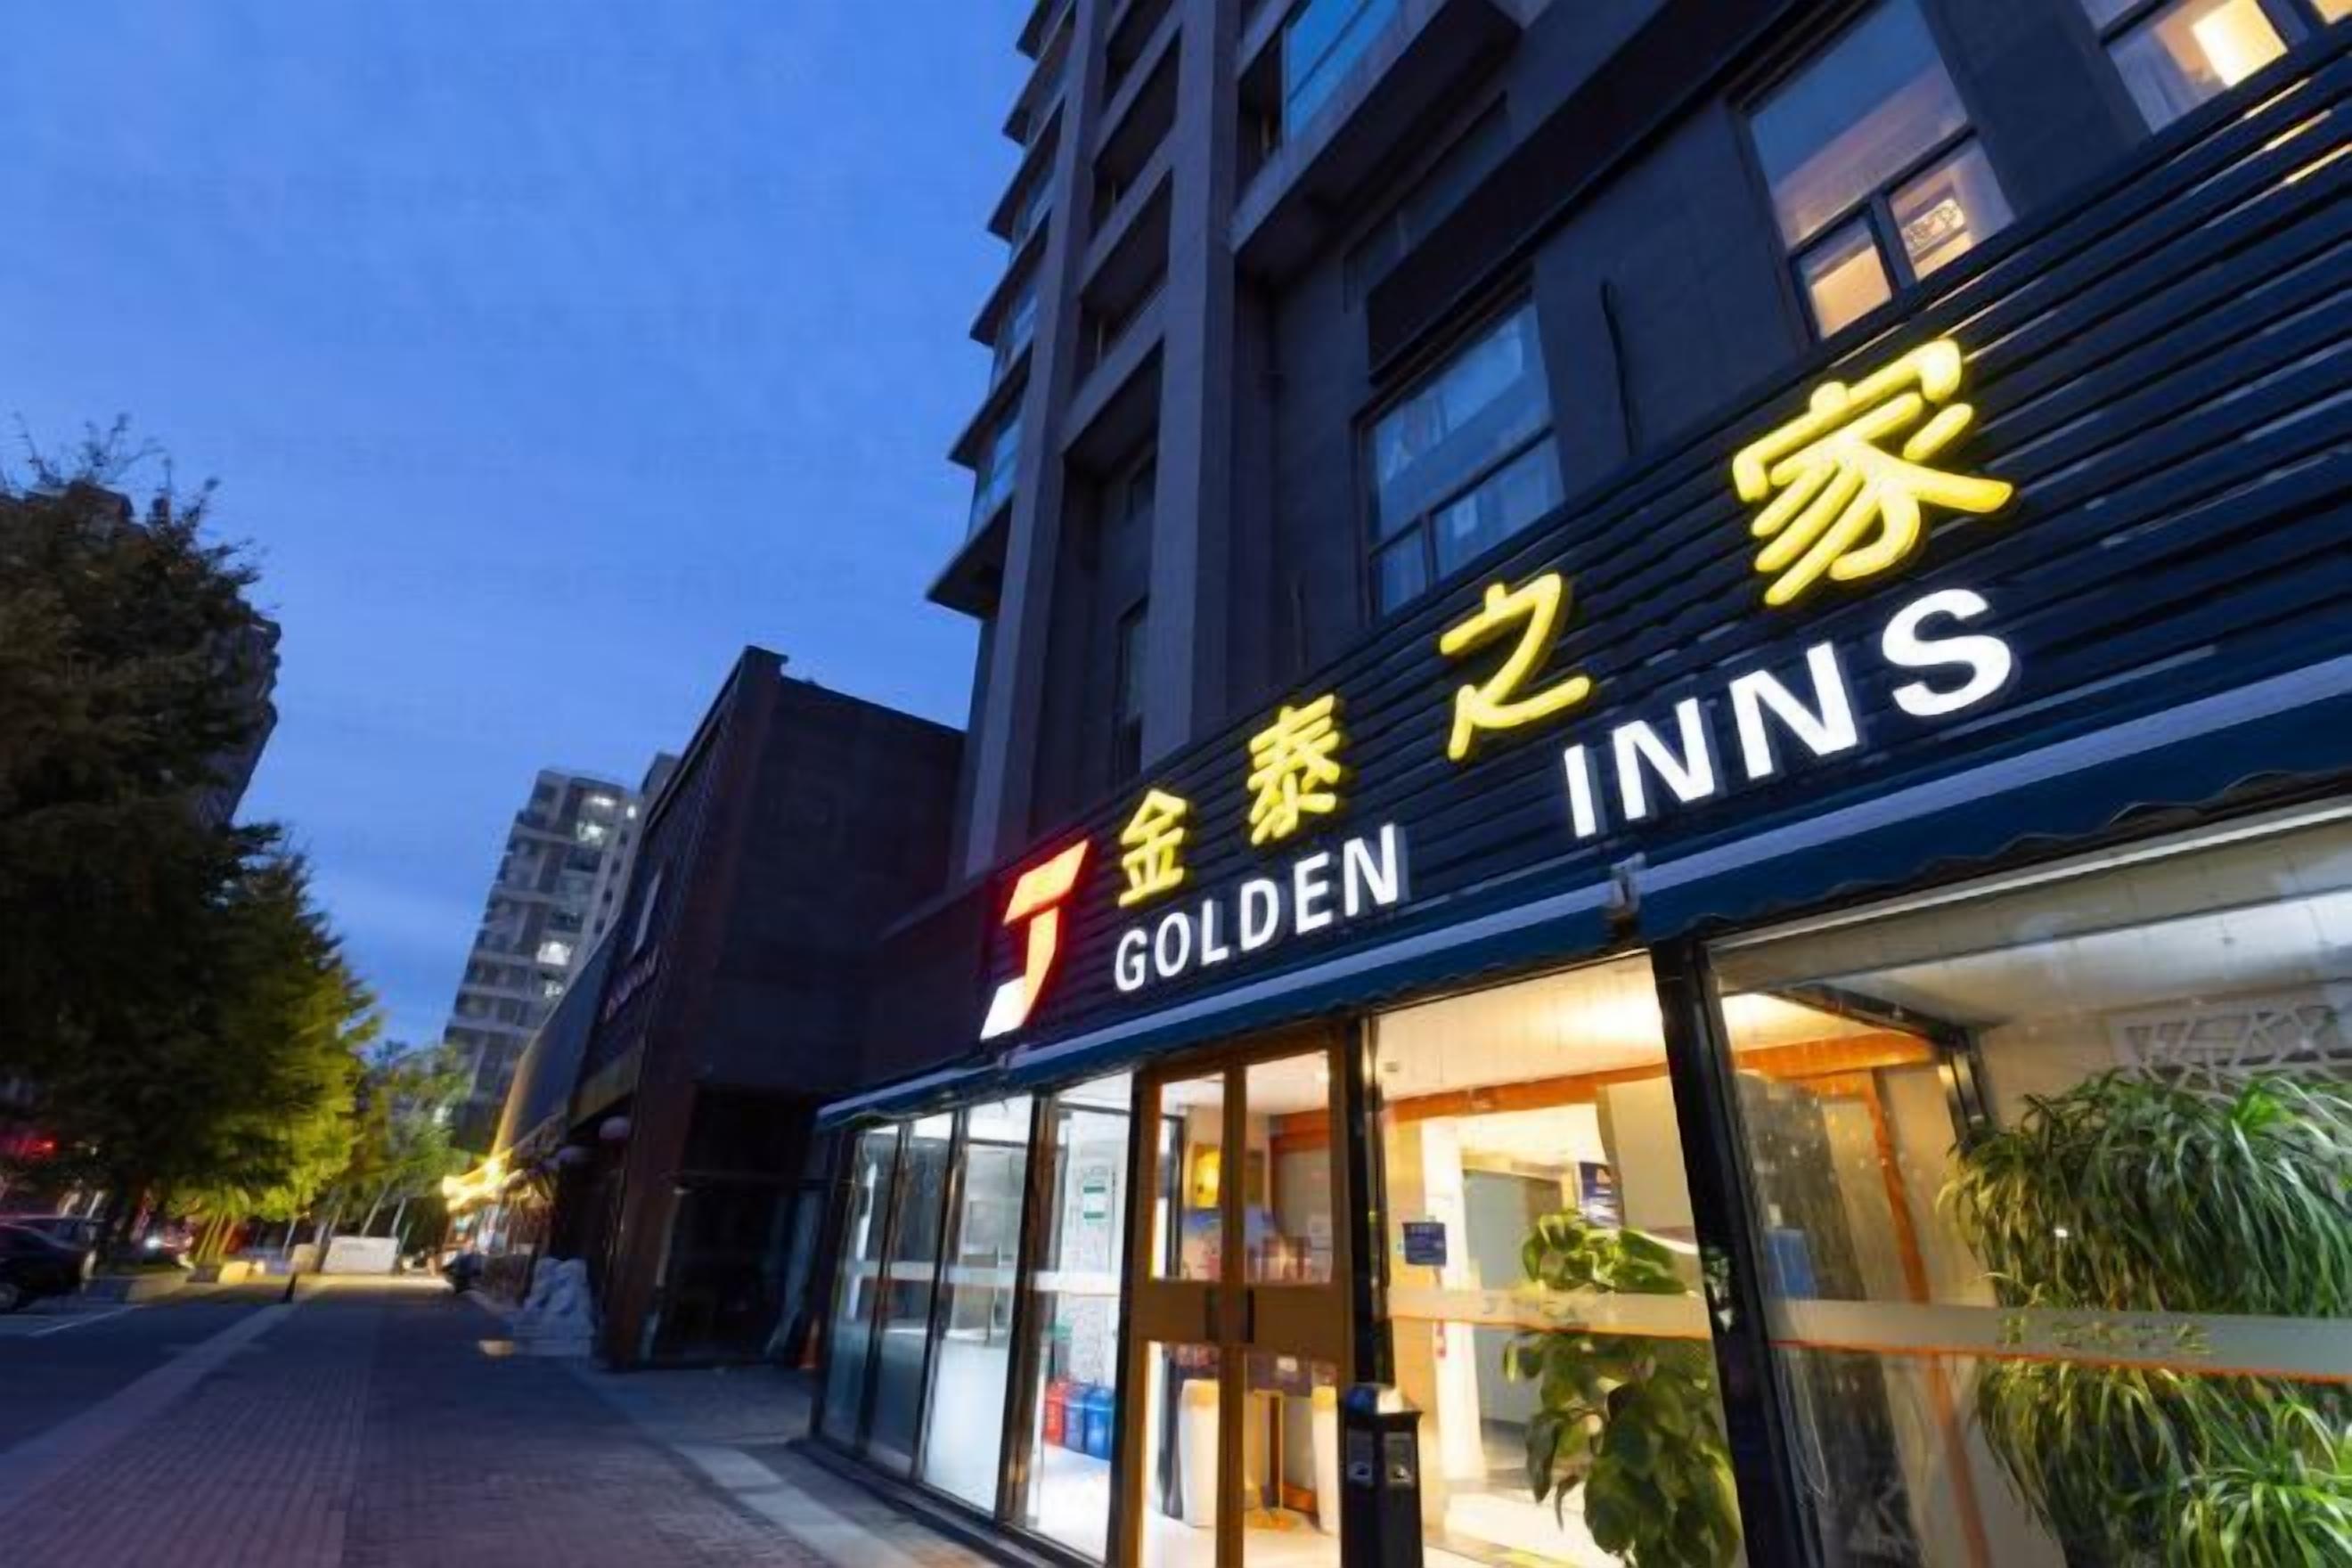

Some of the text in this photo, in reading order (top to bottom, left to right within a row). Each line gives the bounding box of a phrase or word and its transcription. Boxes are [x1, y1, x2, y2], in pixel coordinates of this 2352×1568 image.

[1114, 588, 2013, 992] GOLDEN INNS
[1117, 337, 2013, 907] 金泰之家
